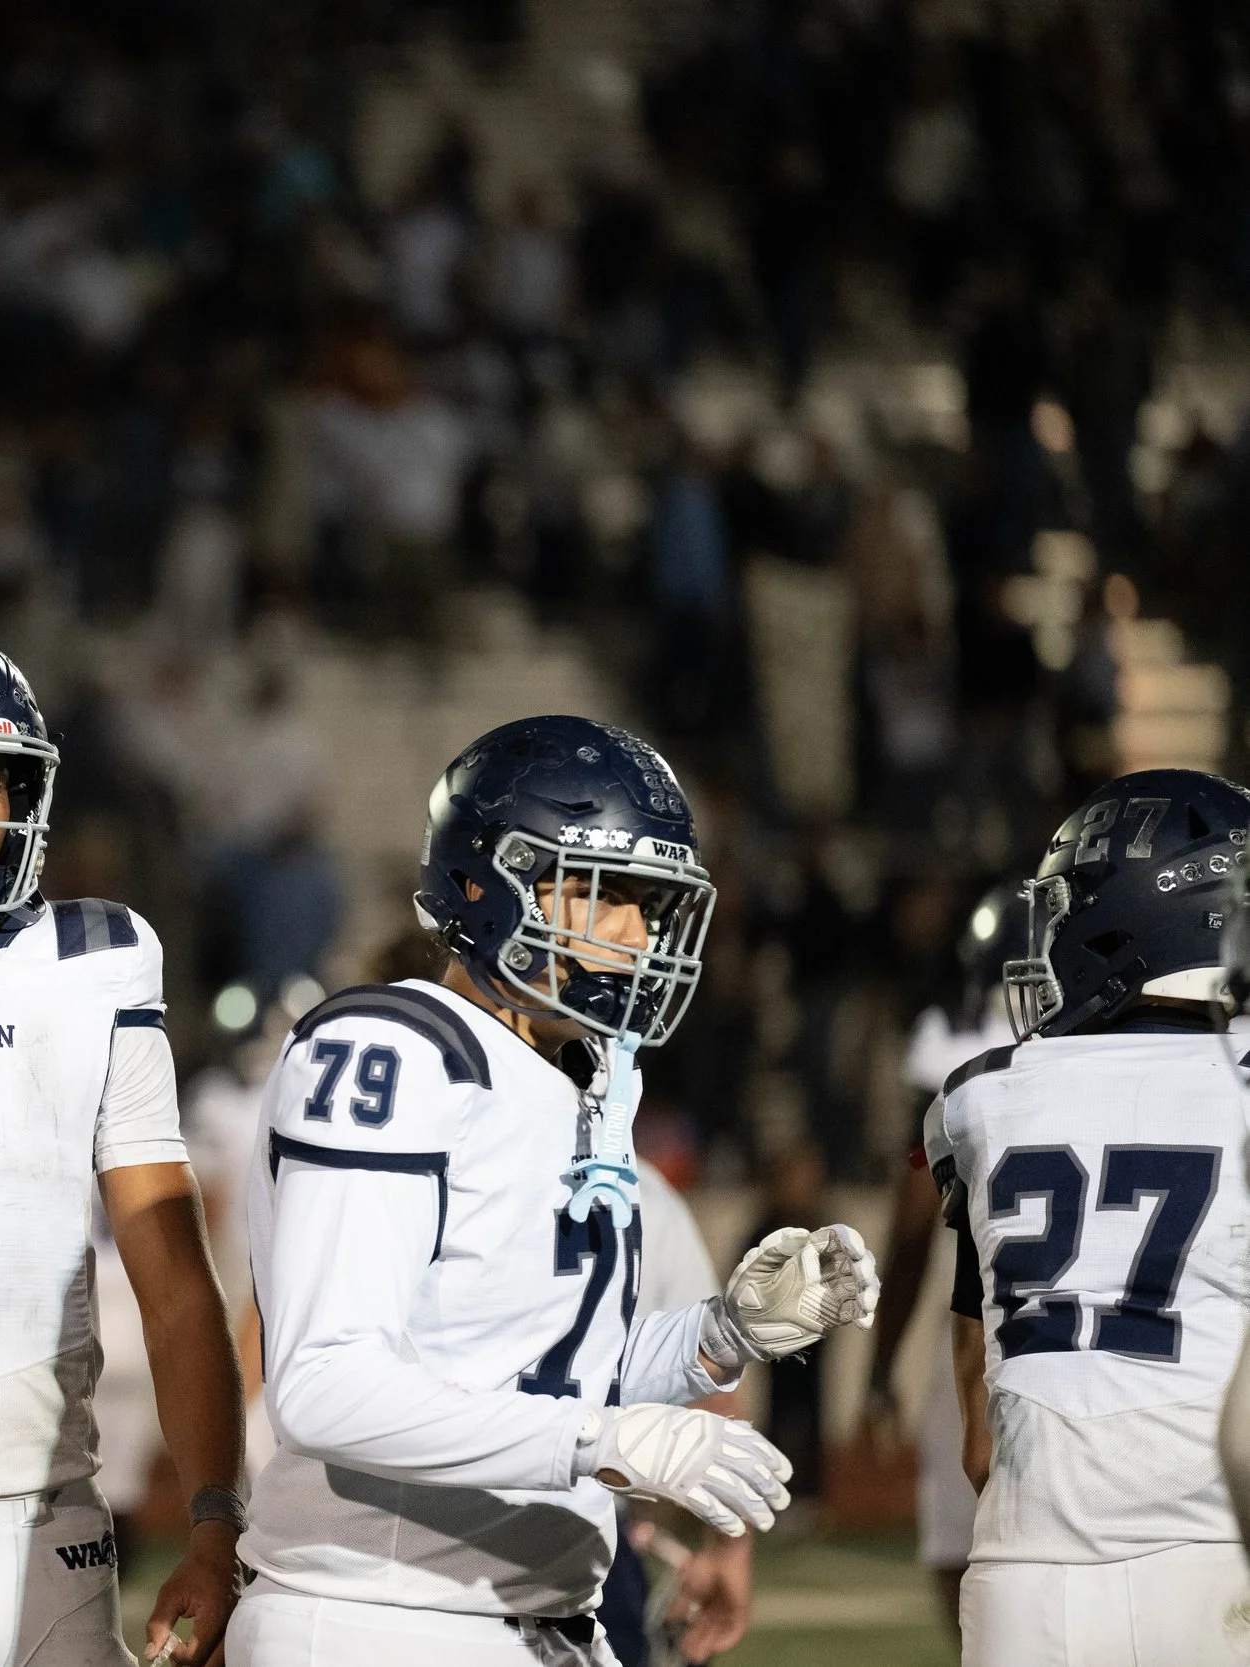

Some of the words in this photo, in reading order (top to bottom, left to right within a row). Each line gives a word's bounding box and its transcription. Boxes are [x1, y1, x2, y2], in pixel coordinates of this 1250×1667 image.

[1074, 797, 1172, 866] 27
[304, 1039, 402, 1130] 79
[601, 1102, 628, 1154] NXTRND
[987, 1143, 1224, 1363] 27
